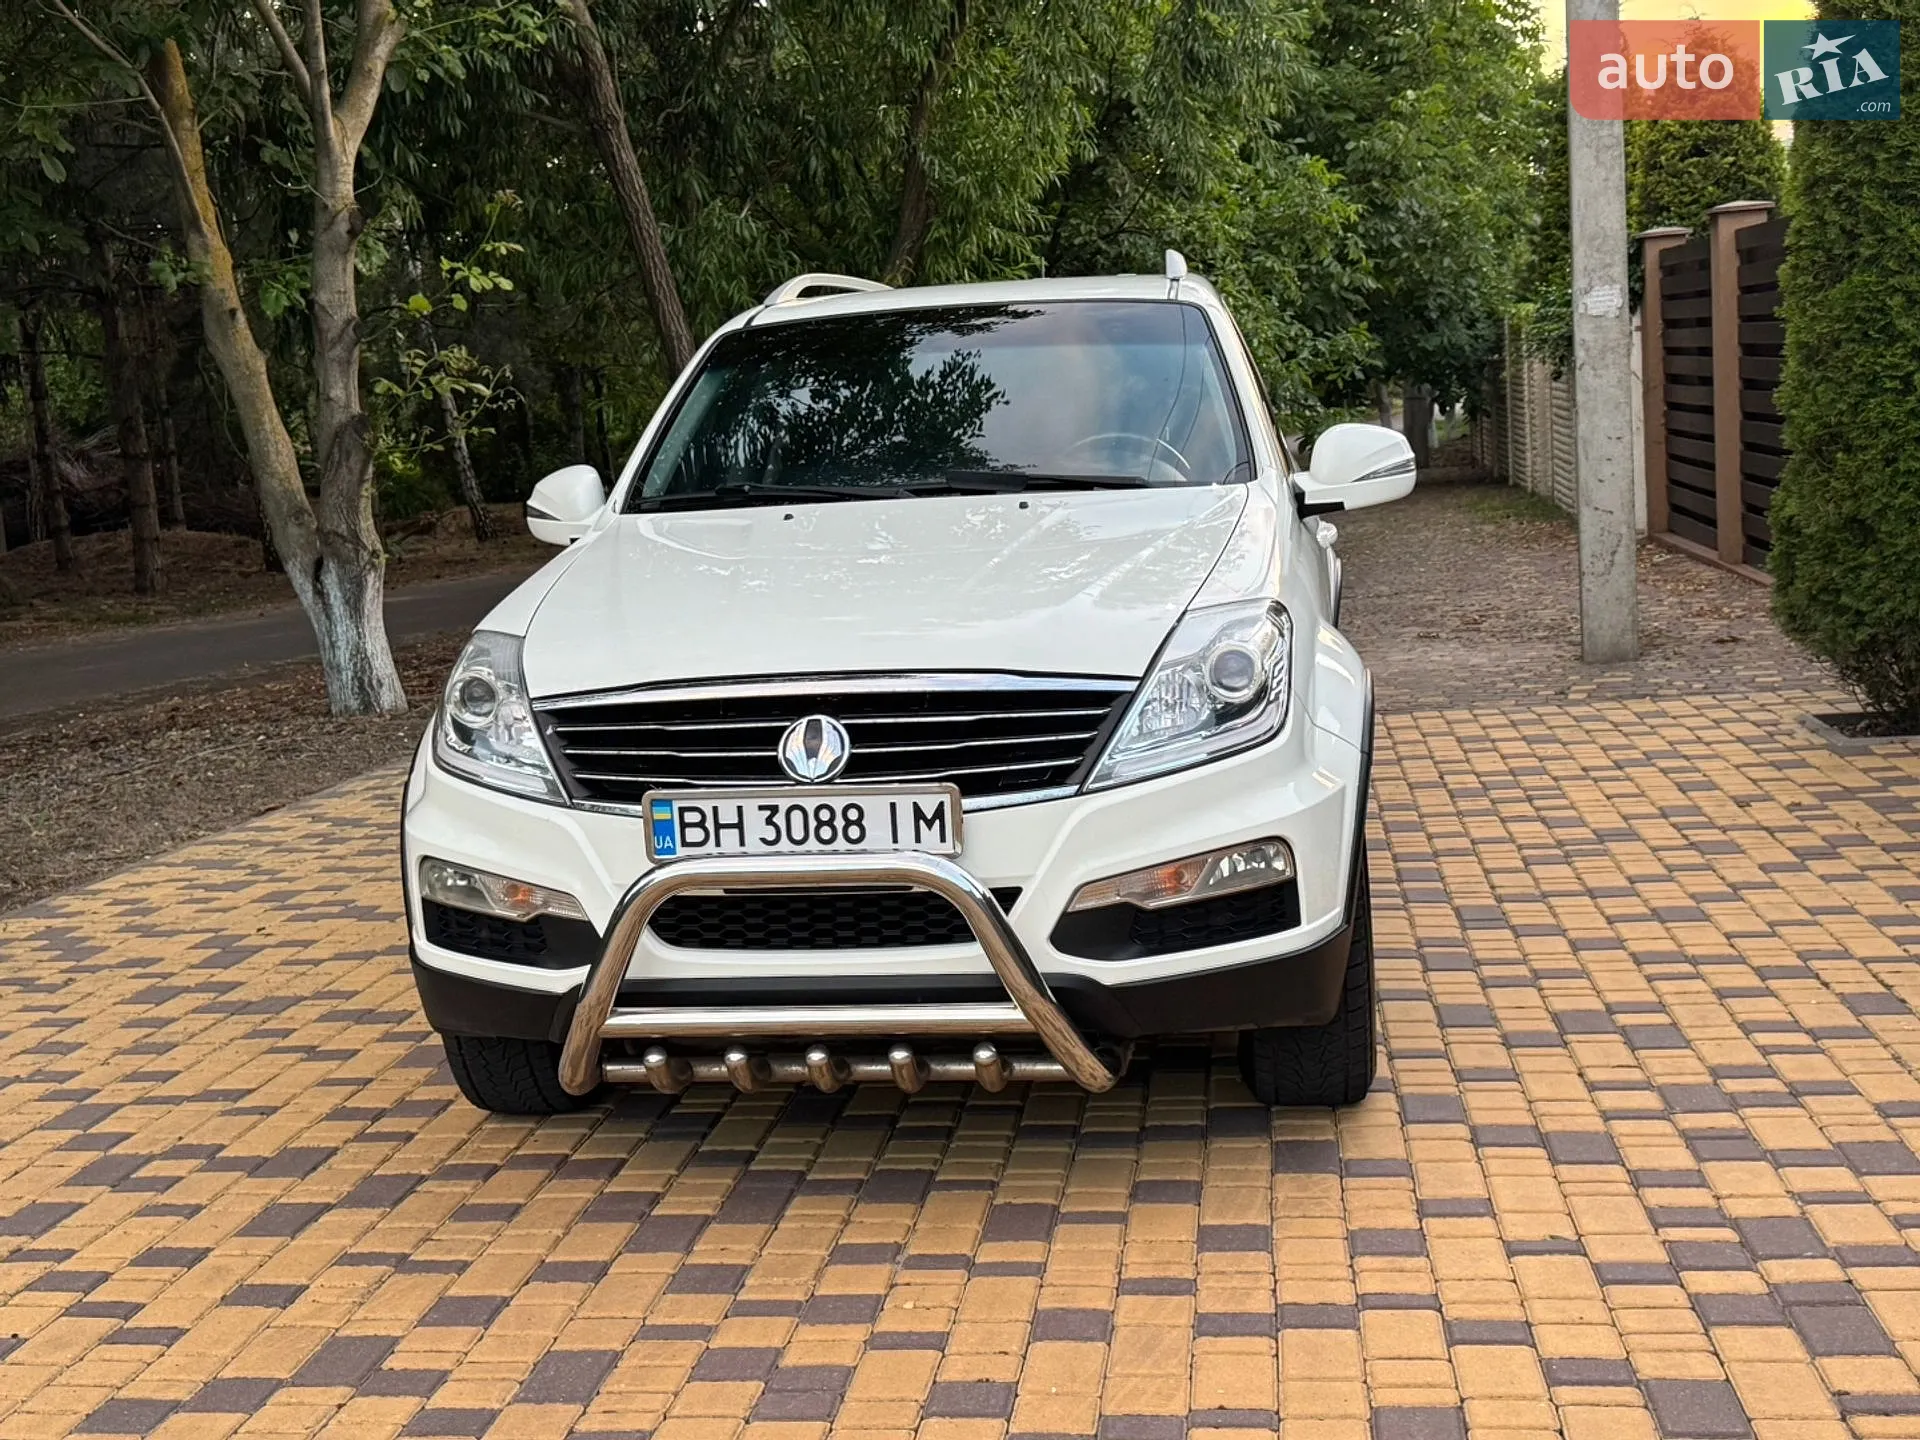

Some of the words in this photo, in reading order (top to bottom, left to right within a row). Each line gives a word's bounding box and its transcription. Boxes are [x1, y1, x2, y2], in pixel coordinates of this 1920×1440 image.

[678, 805, 746, 848] BH
[757, 802, 867, 846] 3088
[889, 800, 947, 844] IM
[654, 835, 674, 850] UA
